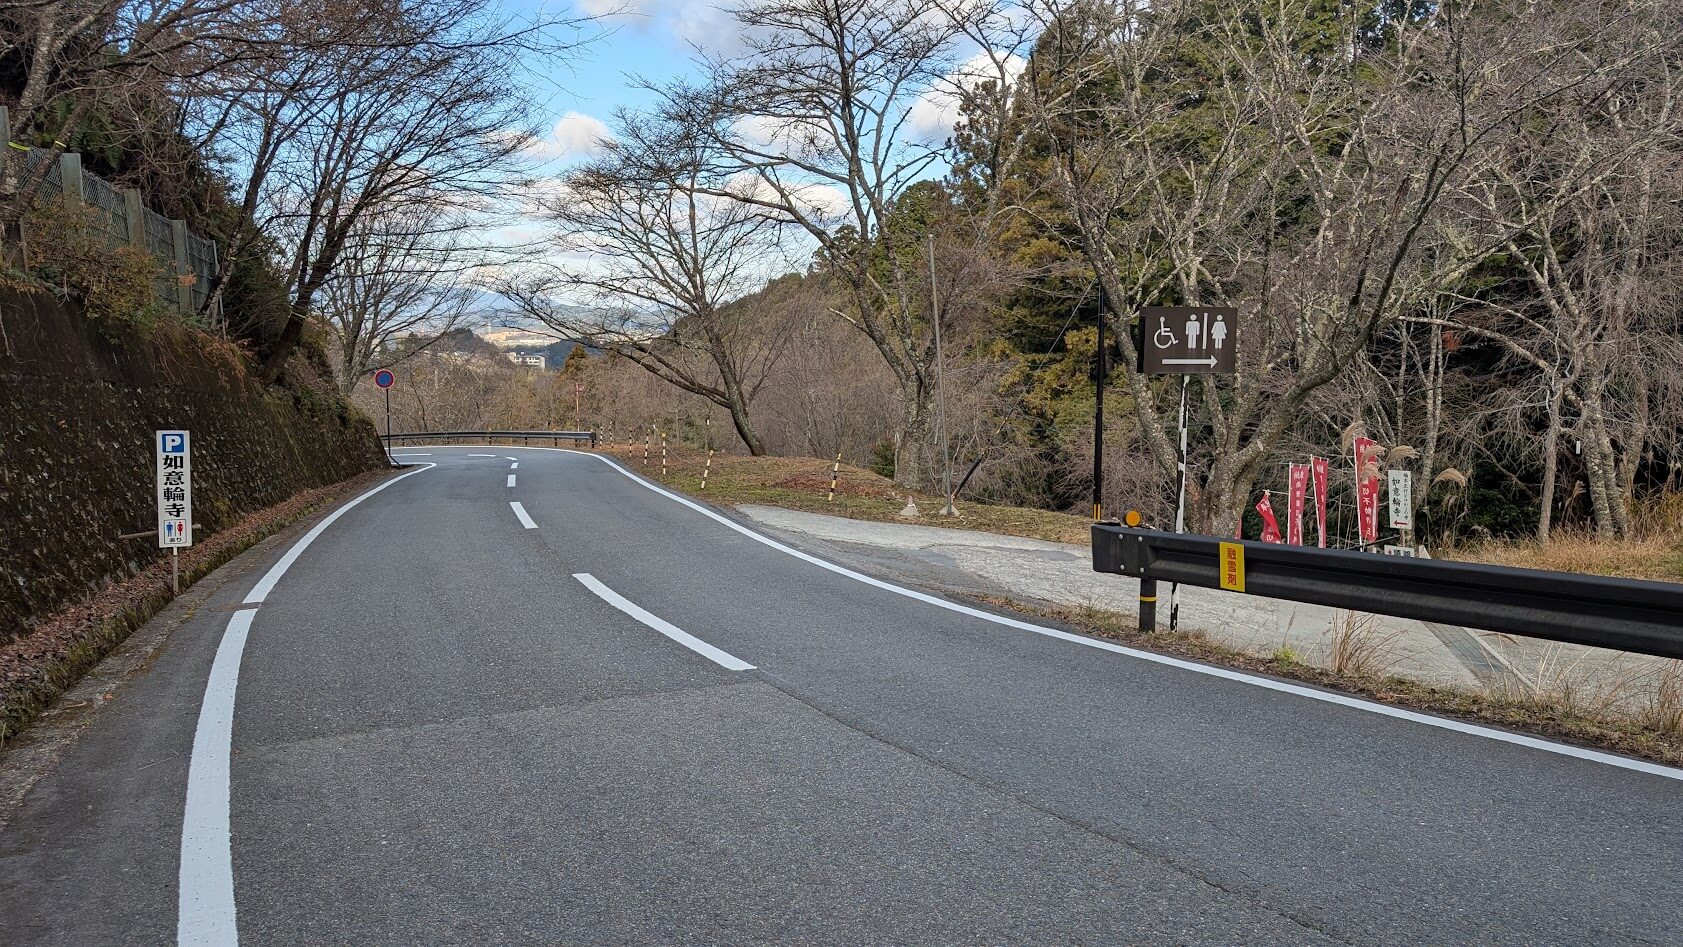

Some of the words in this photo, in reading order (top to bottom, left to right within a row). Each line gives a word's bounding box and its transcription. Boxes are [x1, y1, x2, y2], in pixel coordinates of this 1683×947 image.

[165, 435, 182, 452] P
[162, 454, 185, 518] 如意輪寺
[1391, 476, 1402, 517] 如意輪寺
[1227, 547, 1237, 586] 融雪剤
